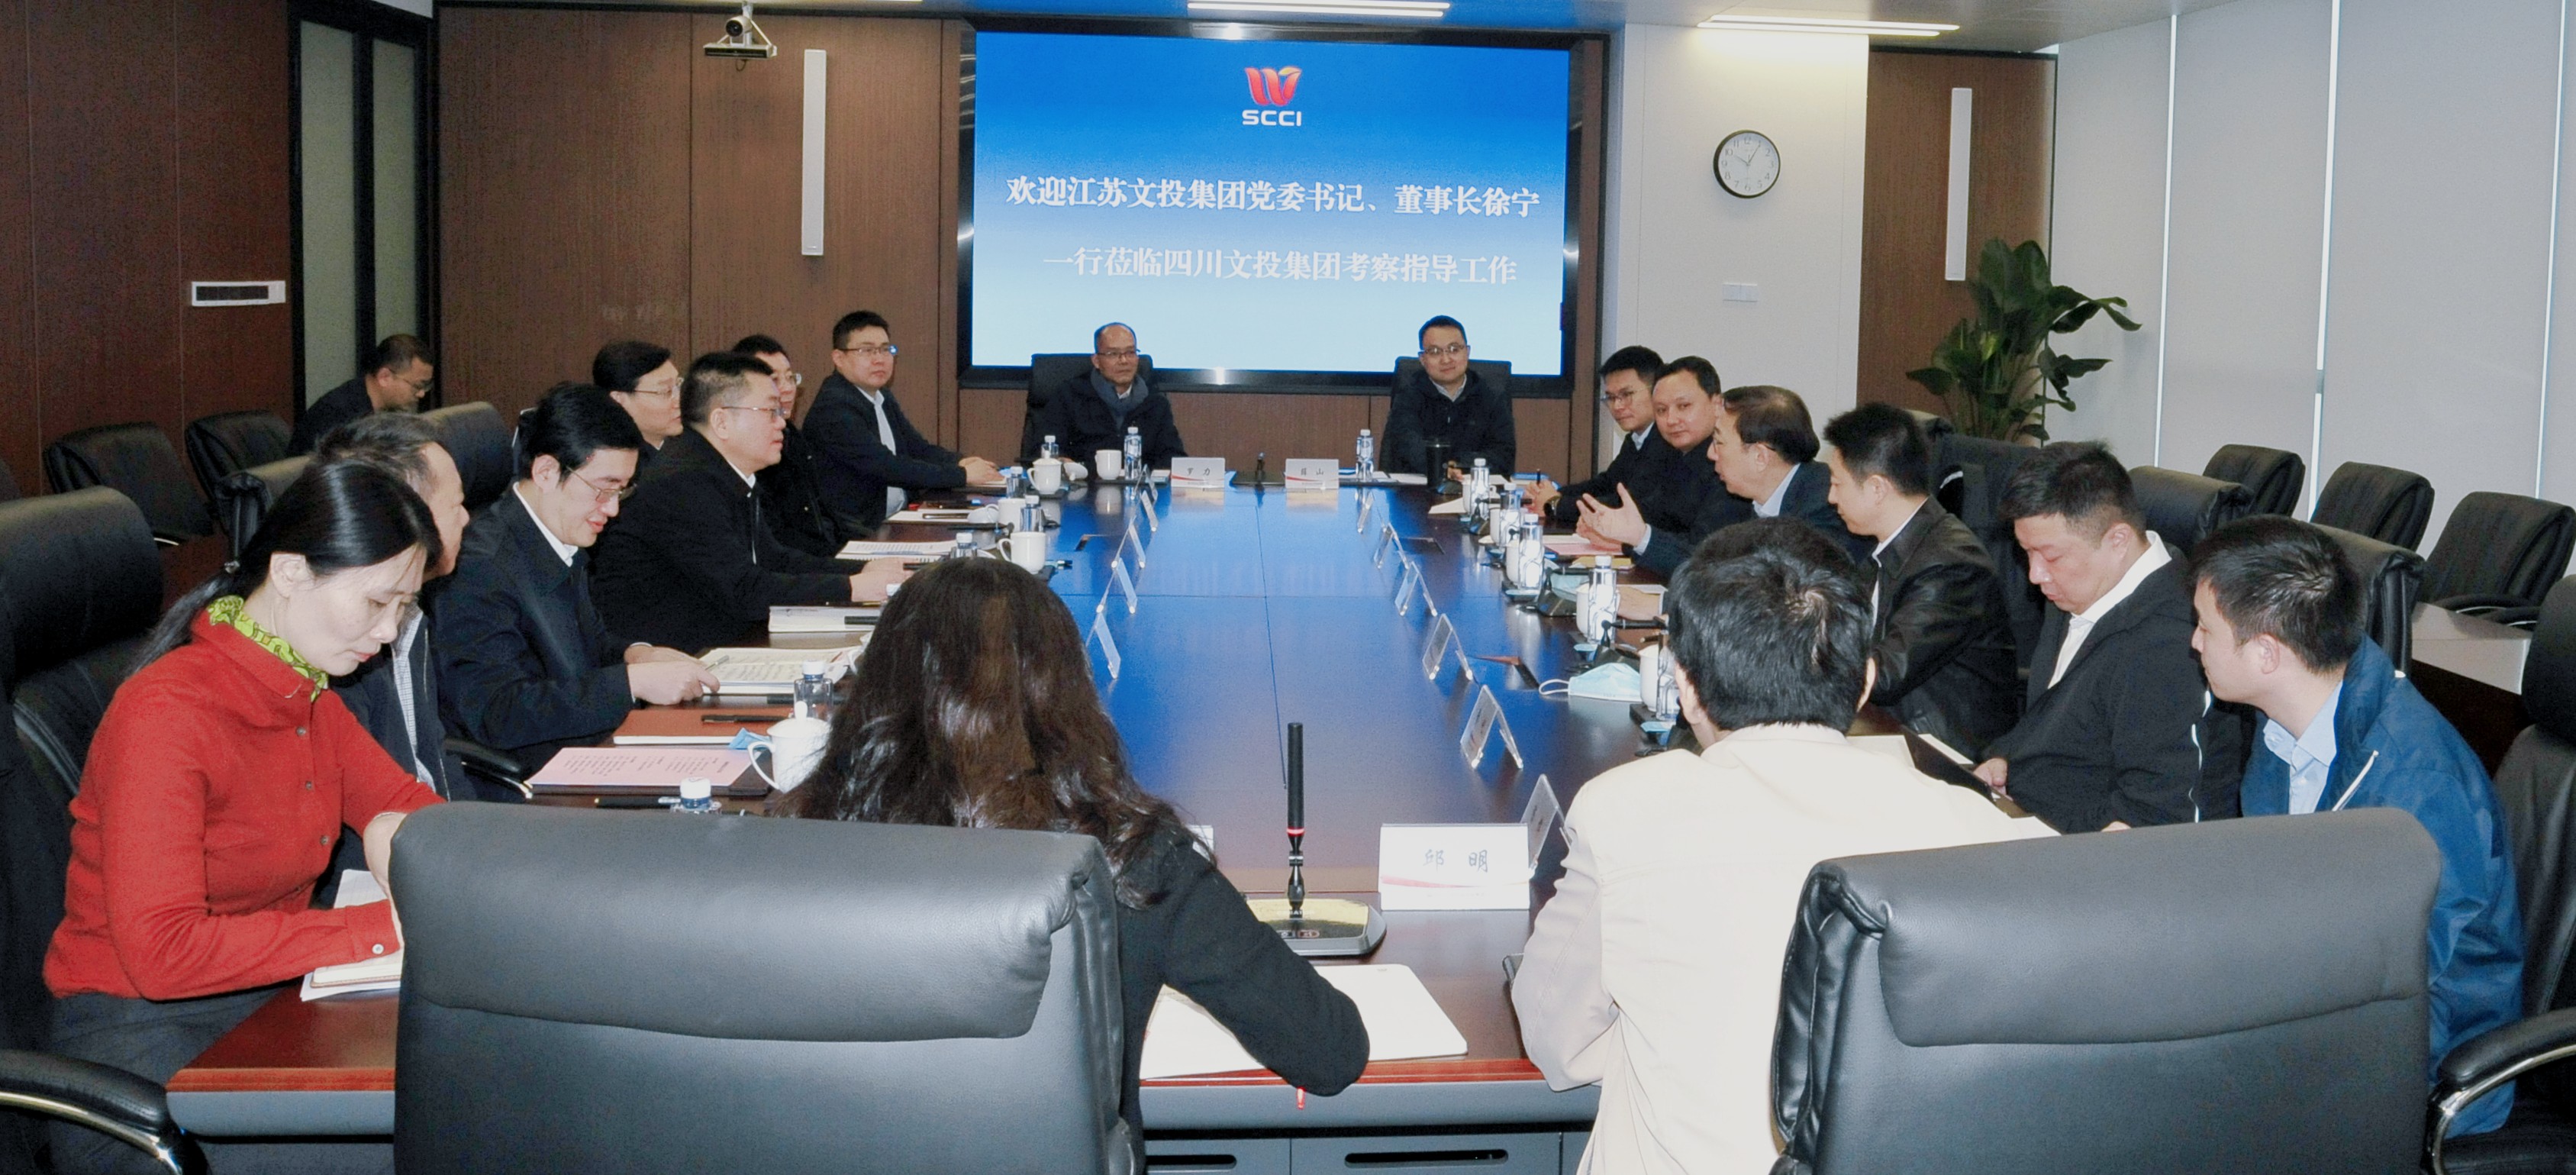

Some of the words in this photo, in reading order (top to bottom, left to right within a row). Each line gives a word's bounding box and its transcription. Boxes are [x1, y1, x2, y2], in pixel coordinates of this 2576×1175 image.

[1242, 109, 1302, 127] SCCI
[1006, 175, 1540, 218] 欢迎江苏文投集团党委书记、董事长徐宁
[1043, 246, 1517, 285] 一行莅临四川文投集团考察指导工作
[1423, 849, 1488, 873] 邱明
